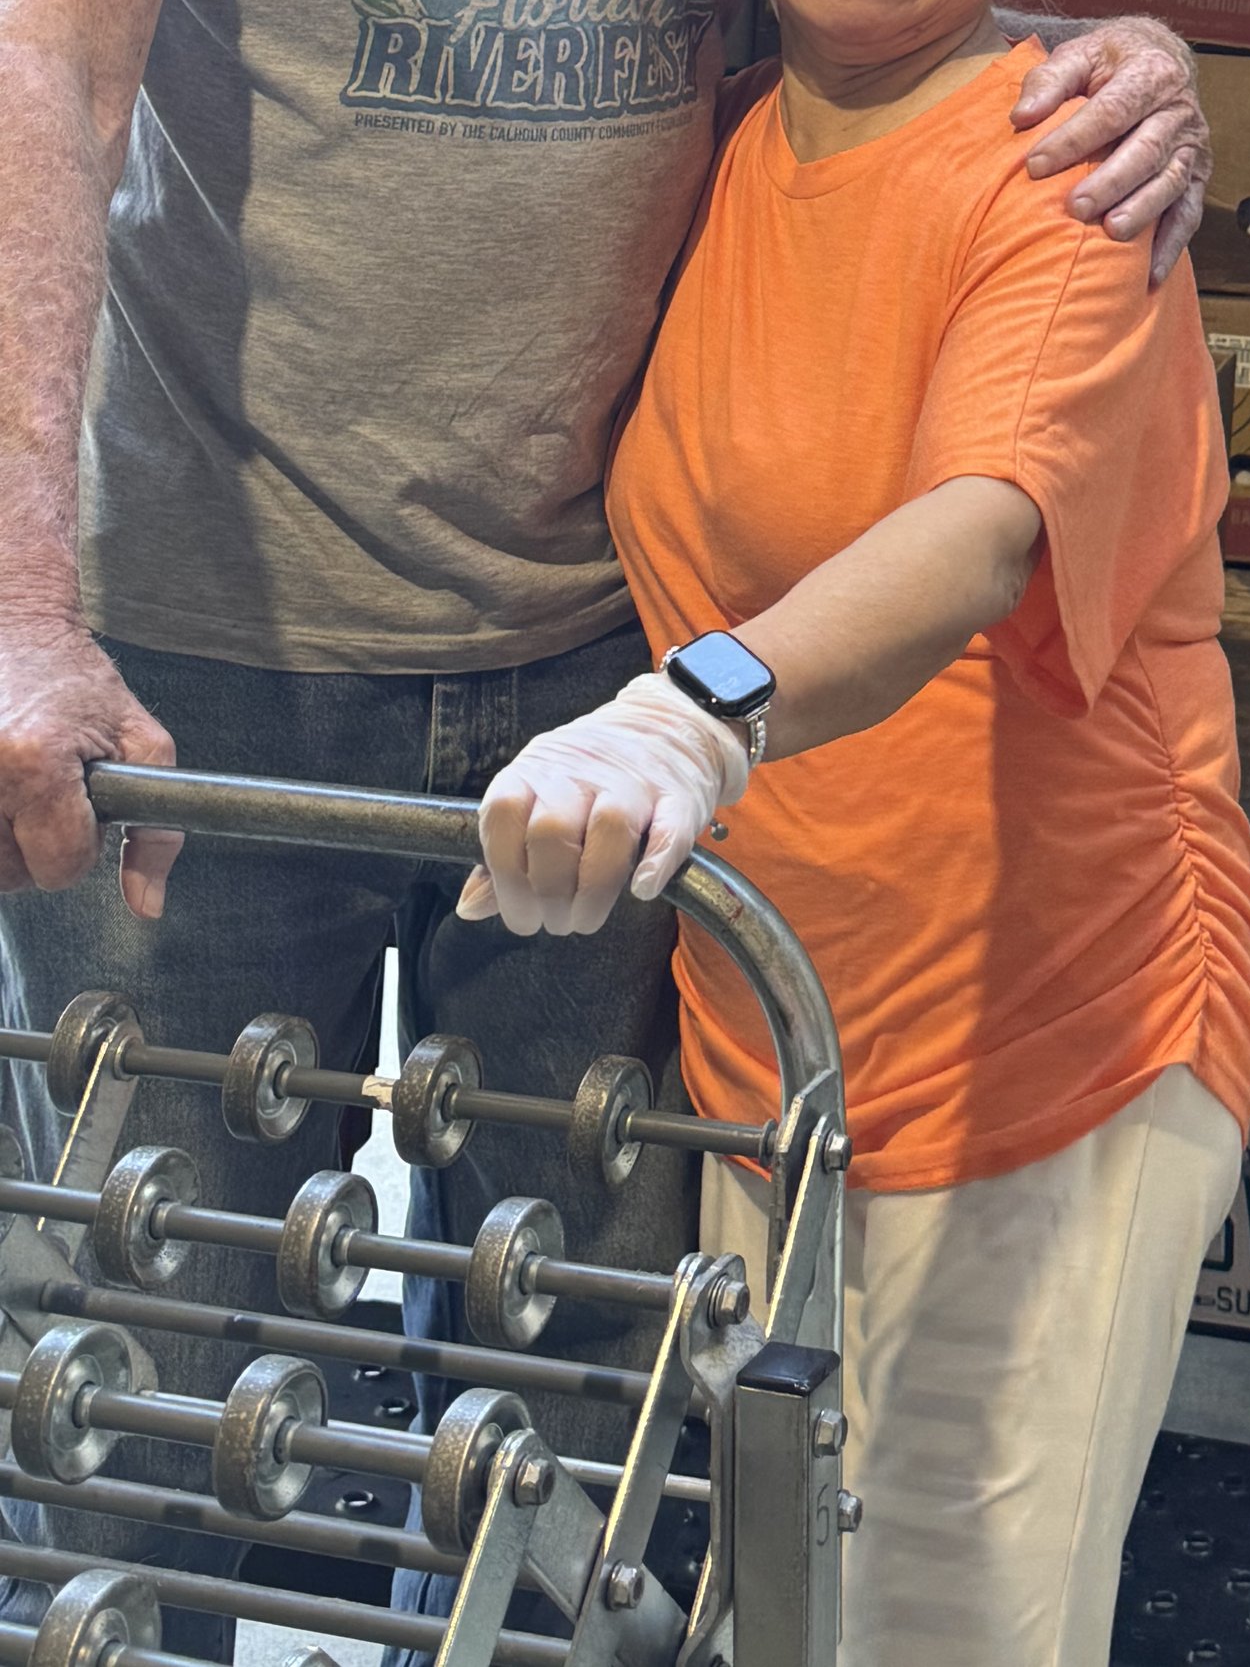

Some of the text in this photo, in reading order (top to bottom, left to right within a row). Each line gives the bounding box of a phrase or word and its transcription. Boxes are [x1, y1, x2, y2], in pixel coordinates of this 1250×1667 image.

[354, 112, 435, 135] PRESENTED
[438, 121, 457, 137] BY
[461, 124, 486, 140] THE
[490, 124, 548, 143] CALHOUN
[552, 126, 597, 143] COUNTY
